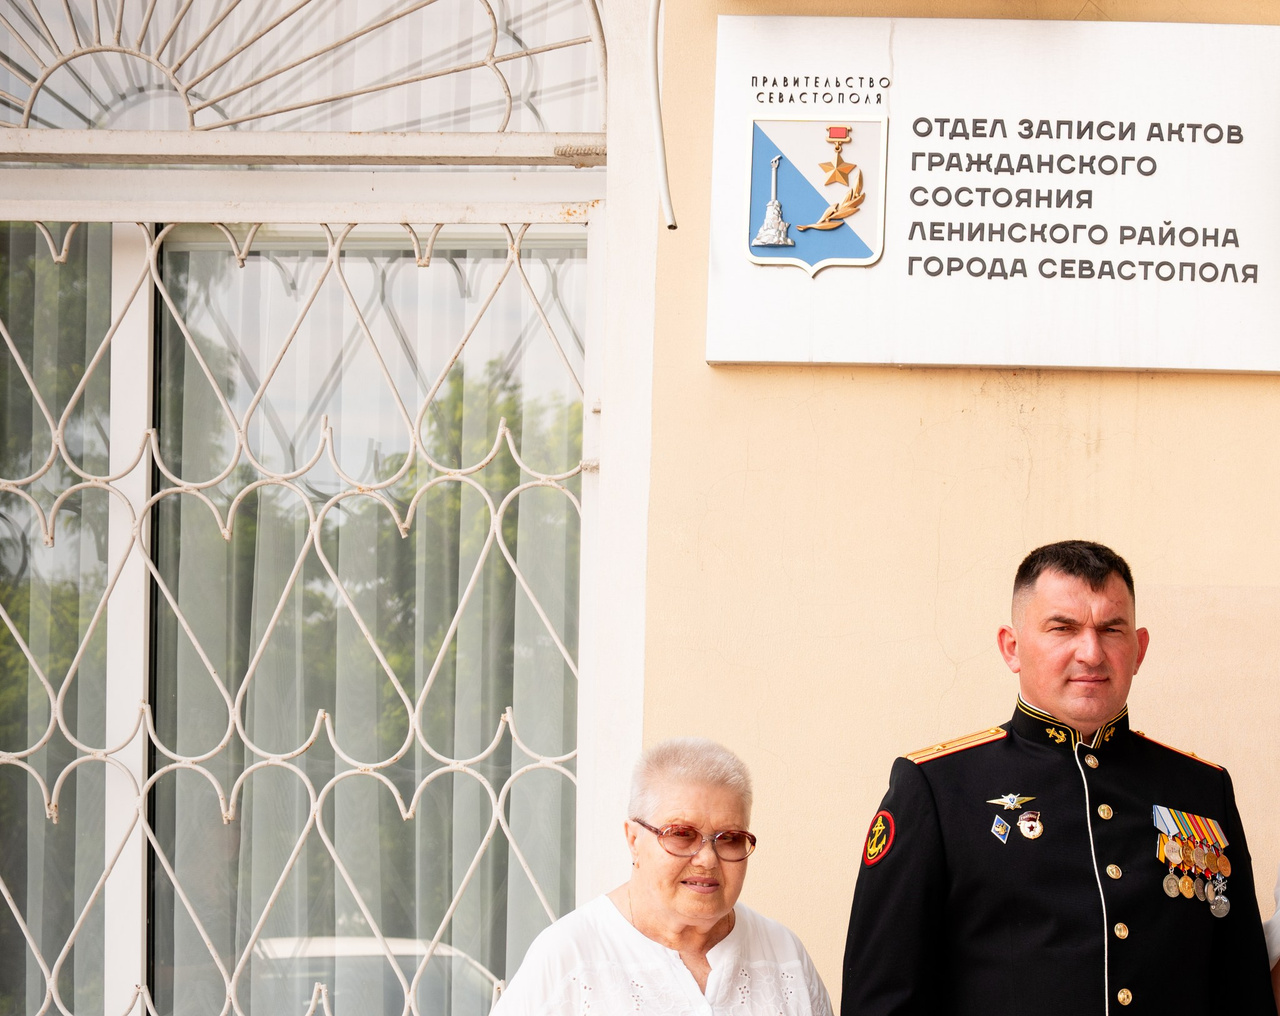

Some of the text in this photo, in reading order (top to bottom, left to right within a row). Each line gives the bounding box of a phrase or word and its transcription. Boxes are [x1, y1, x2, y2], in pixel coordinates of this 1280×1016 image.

[751, 76, 891, 89] ПРАВИТЕЛЬСТВО
[756, 92, 882, 104] СЕВАСТОПОЛЯ
[912, 117, 1244, 144] ОТДЕЛ ЗАПИСИ АКТОВ
[911, 152, 1157, 177] ГРАЖДАНСКОГО
[909, 186, 1093, 209] СОСТОЯНИЯ
[908, 220, 1240, 248] ЛЕНИНСКОГО РАЙОНА
[908, 256, 1258, 284] ГОРОДА СЕВАСТОПОЛЯ
